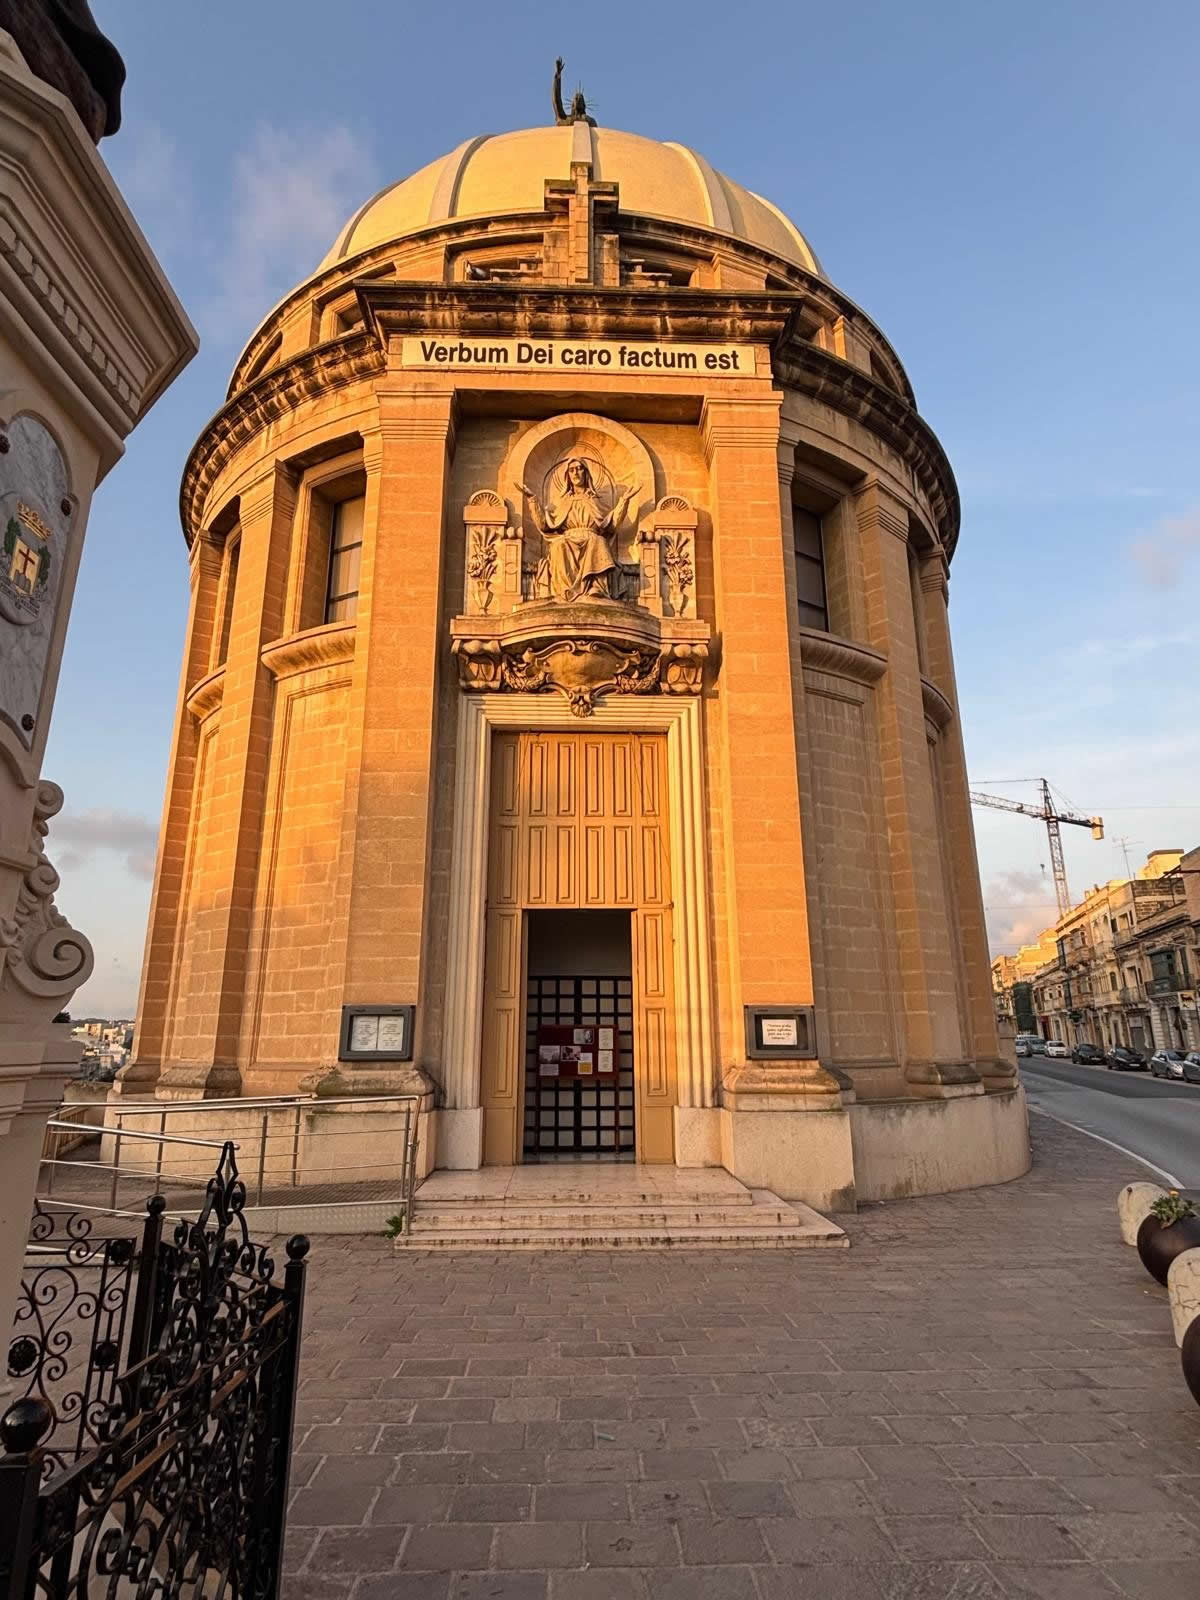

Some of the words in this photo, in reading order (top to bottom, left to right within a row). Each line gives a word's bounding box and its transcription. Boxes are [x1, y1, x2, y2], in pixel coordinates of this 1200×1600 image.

[420, 340, 509, 364] Verbum
[516, 342, 553, 365] Dei
[560, 348, 612, 367] caro
[618, 345, 698, 370] factum
[704, 350, 740, 371] est
